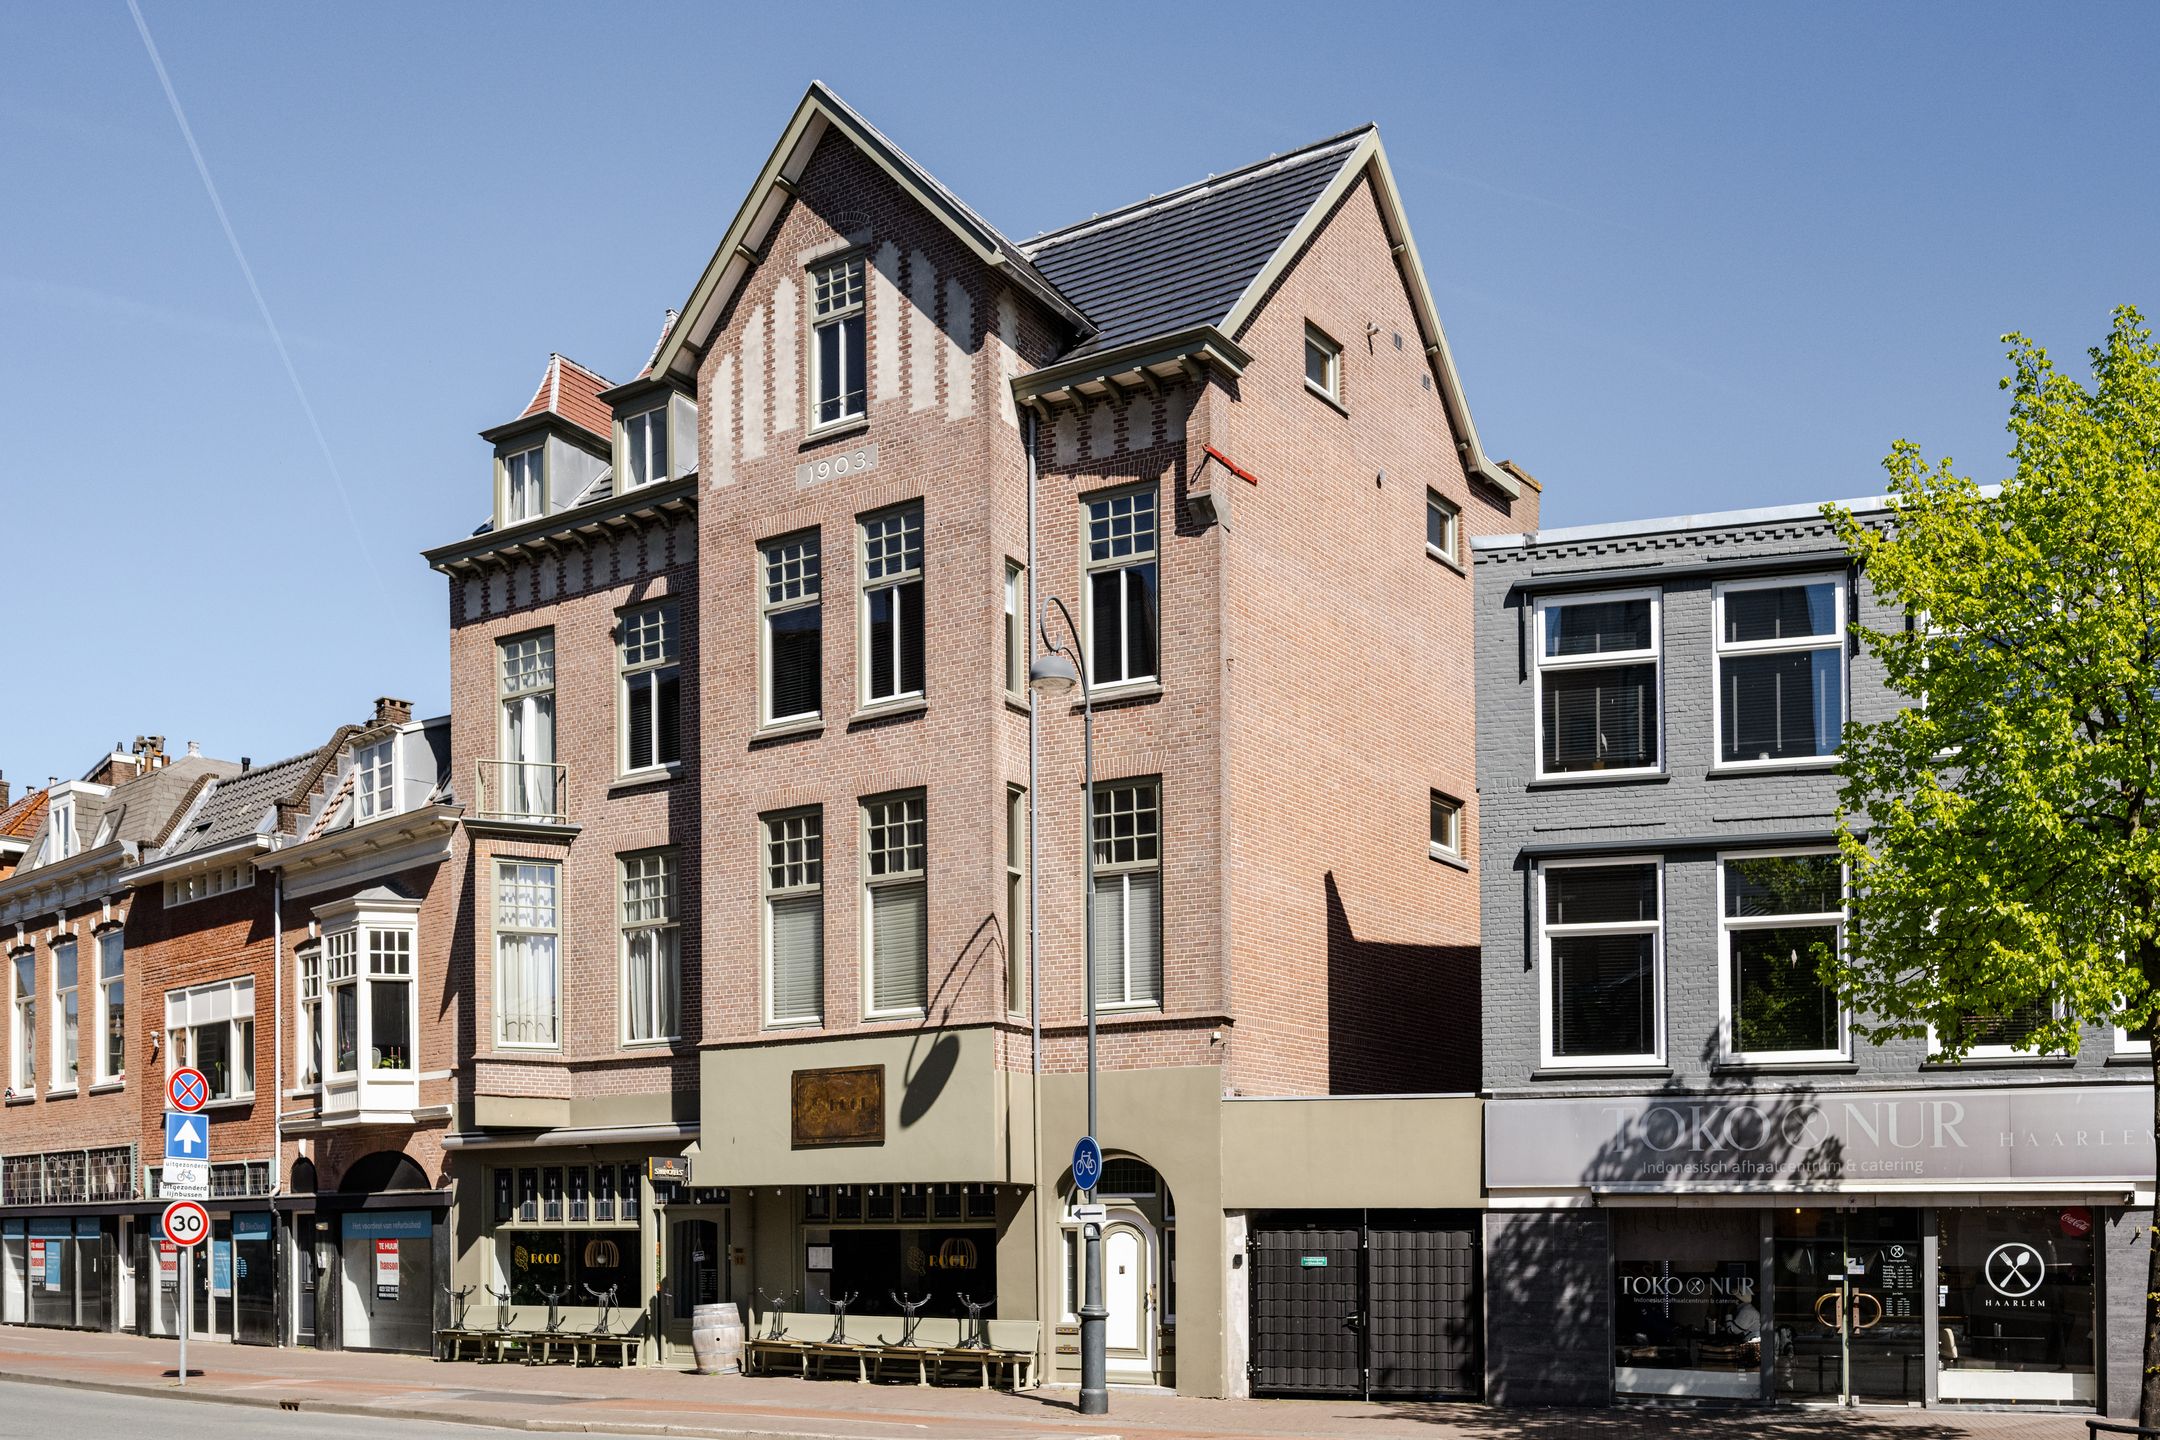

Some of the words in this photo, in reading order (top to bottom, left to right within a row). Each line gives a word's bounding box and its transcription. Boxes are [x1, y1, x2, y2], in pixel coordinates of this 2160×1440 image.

[1601, 1105, 1771, 1152] TOKO
[1843, 1101, 1968, 1150] NUR
[1643, 1160, 1728, 1174] Indonesisch
[1731, 1159, 1841, 1174] afhaalcentrum
[1846, 1159, 1857, 1172] &
[1861, 1157, 1924, 1174] catering
[162, 1184, 207, 1192] uitgezonderd
[173, 1215, 201, 1232] 30
[531, 1253, 561, 1264] ROOD
[1618, 1276, 1683, 1295] TOKO
[1709, 1277, 1755, 1296] NUR
